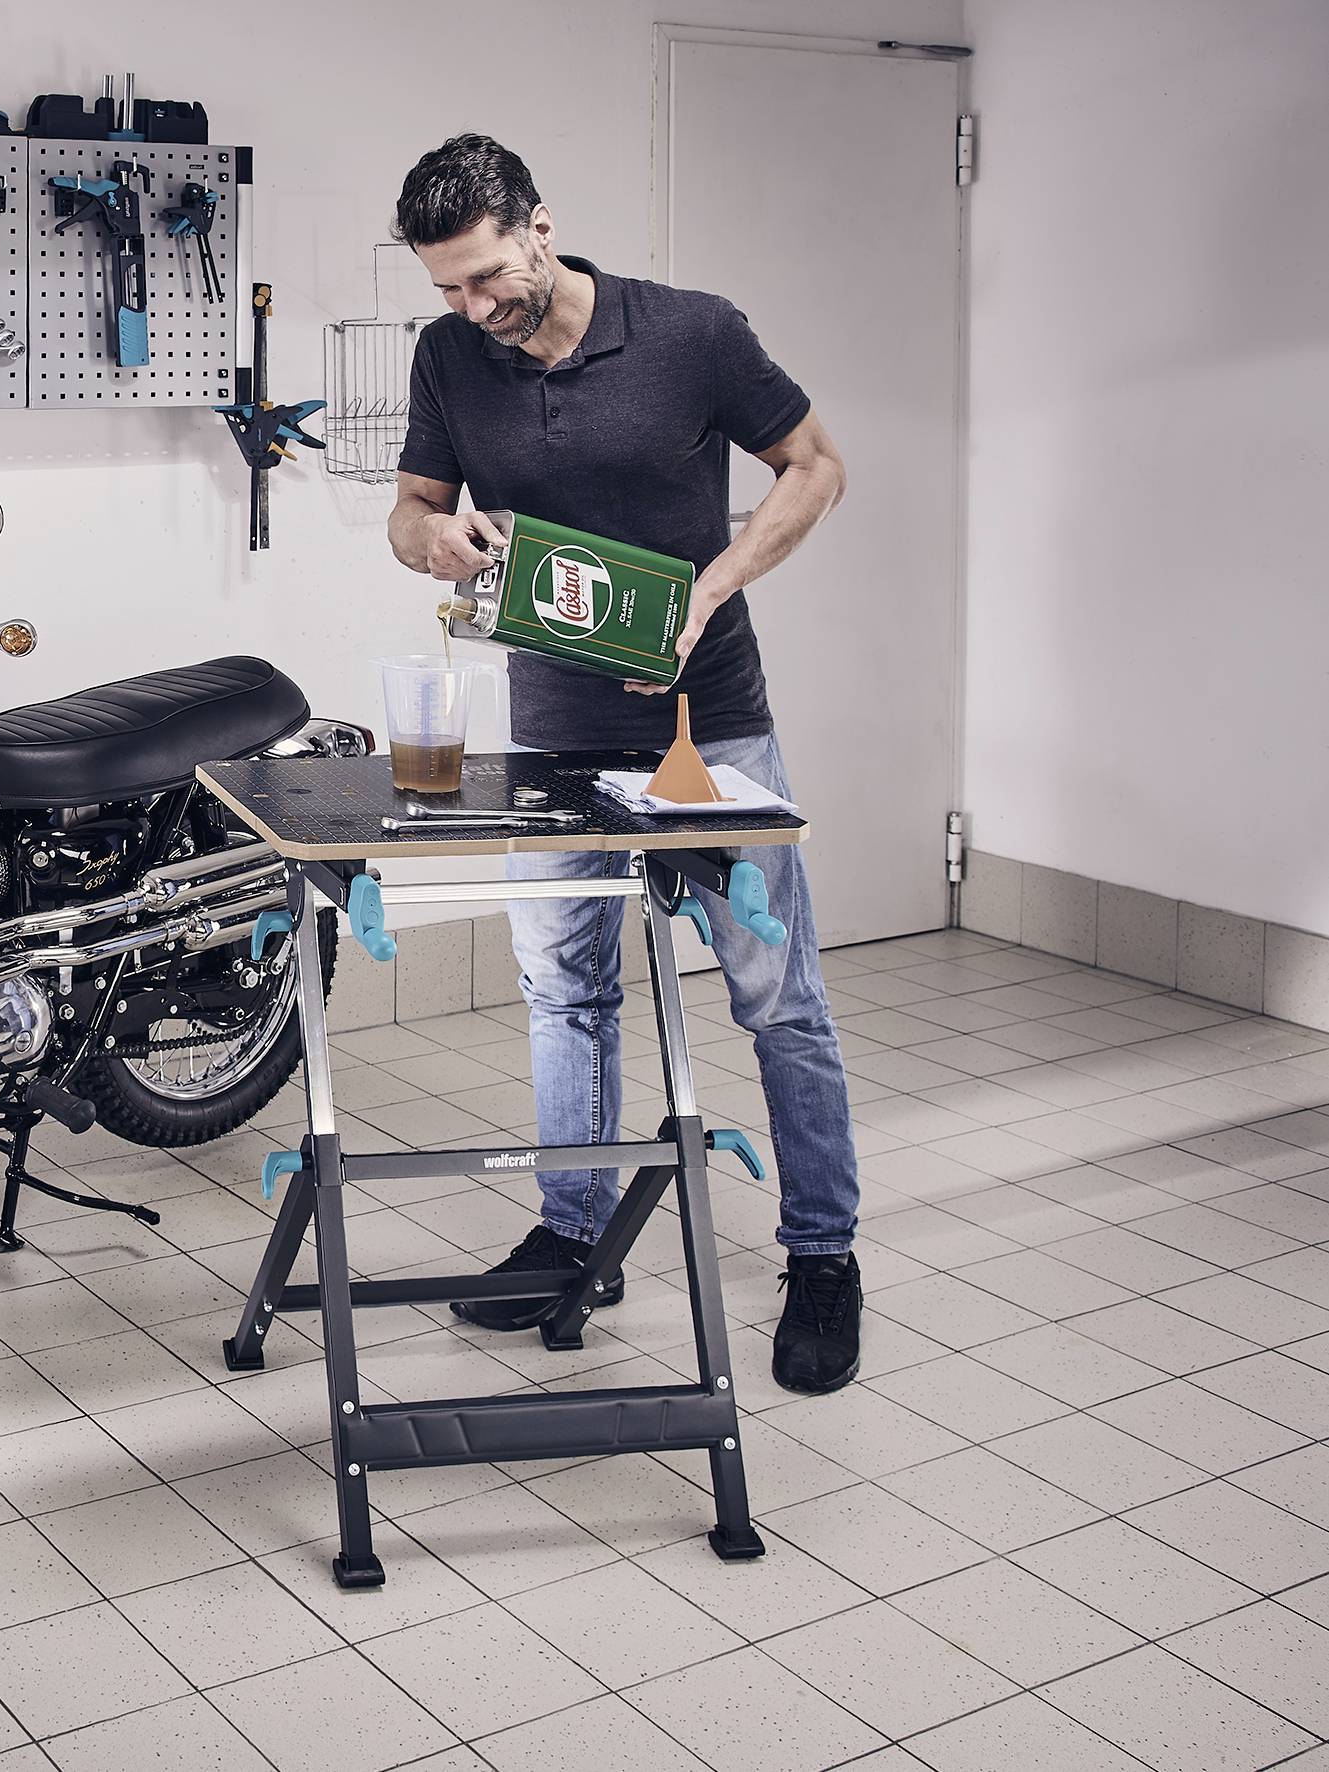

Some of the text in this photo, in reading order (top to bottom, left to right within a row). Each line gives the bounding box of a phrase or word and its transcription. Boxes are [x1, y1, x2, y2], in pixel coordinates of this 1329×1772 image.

[555, 560, 590, 622] Castrol
[619, 590, 630, 623] CLASSIC
[76, 850, 120, 876] Trophy
[84, 874, 106, 891] 650
[483, 1151, 538, 1169] wolfcraft
